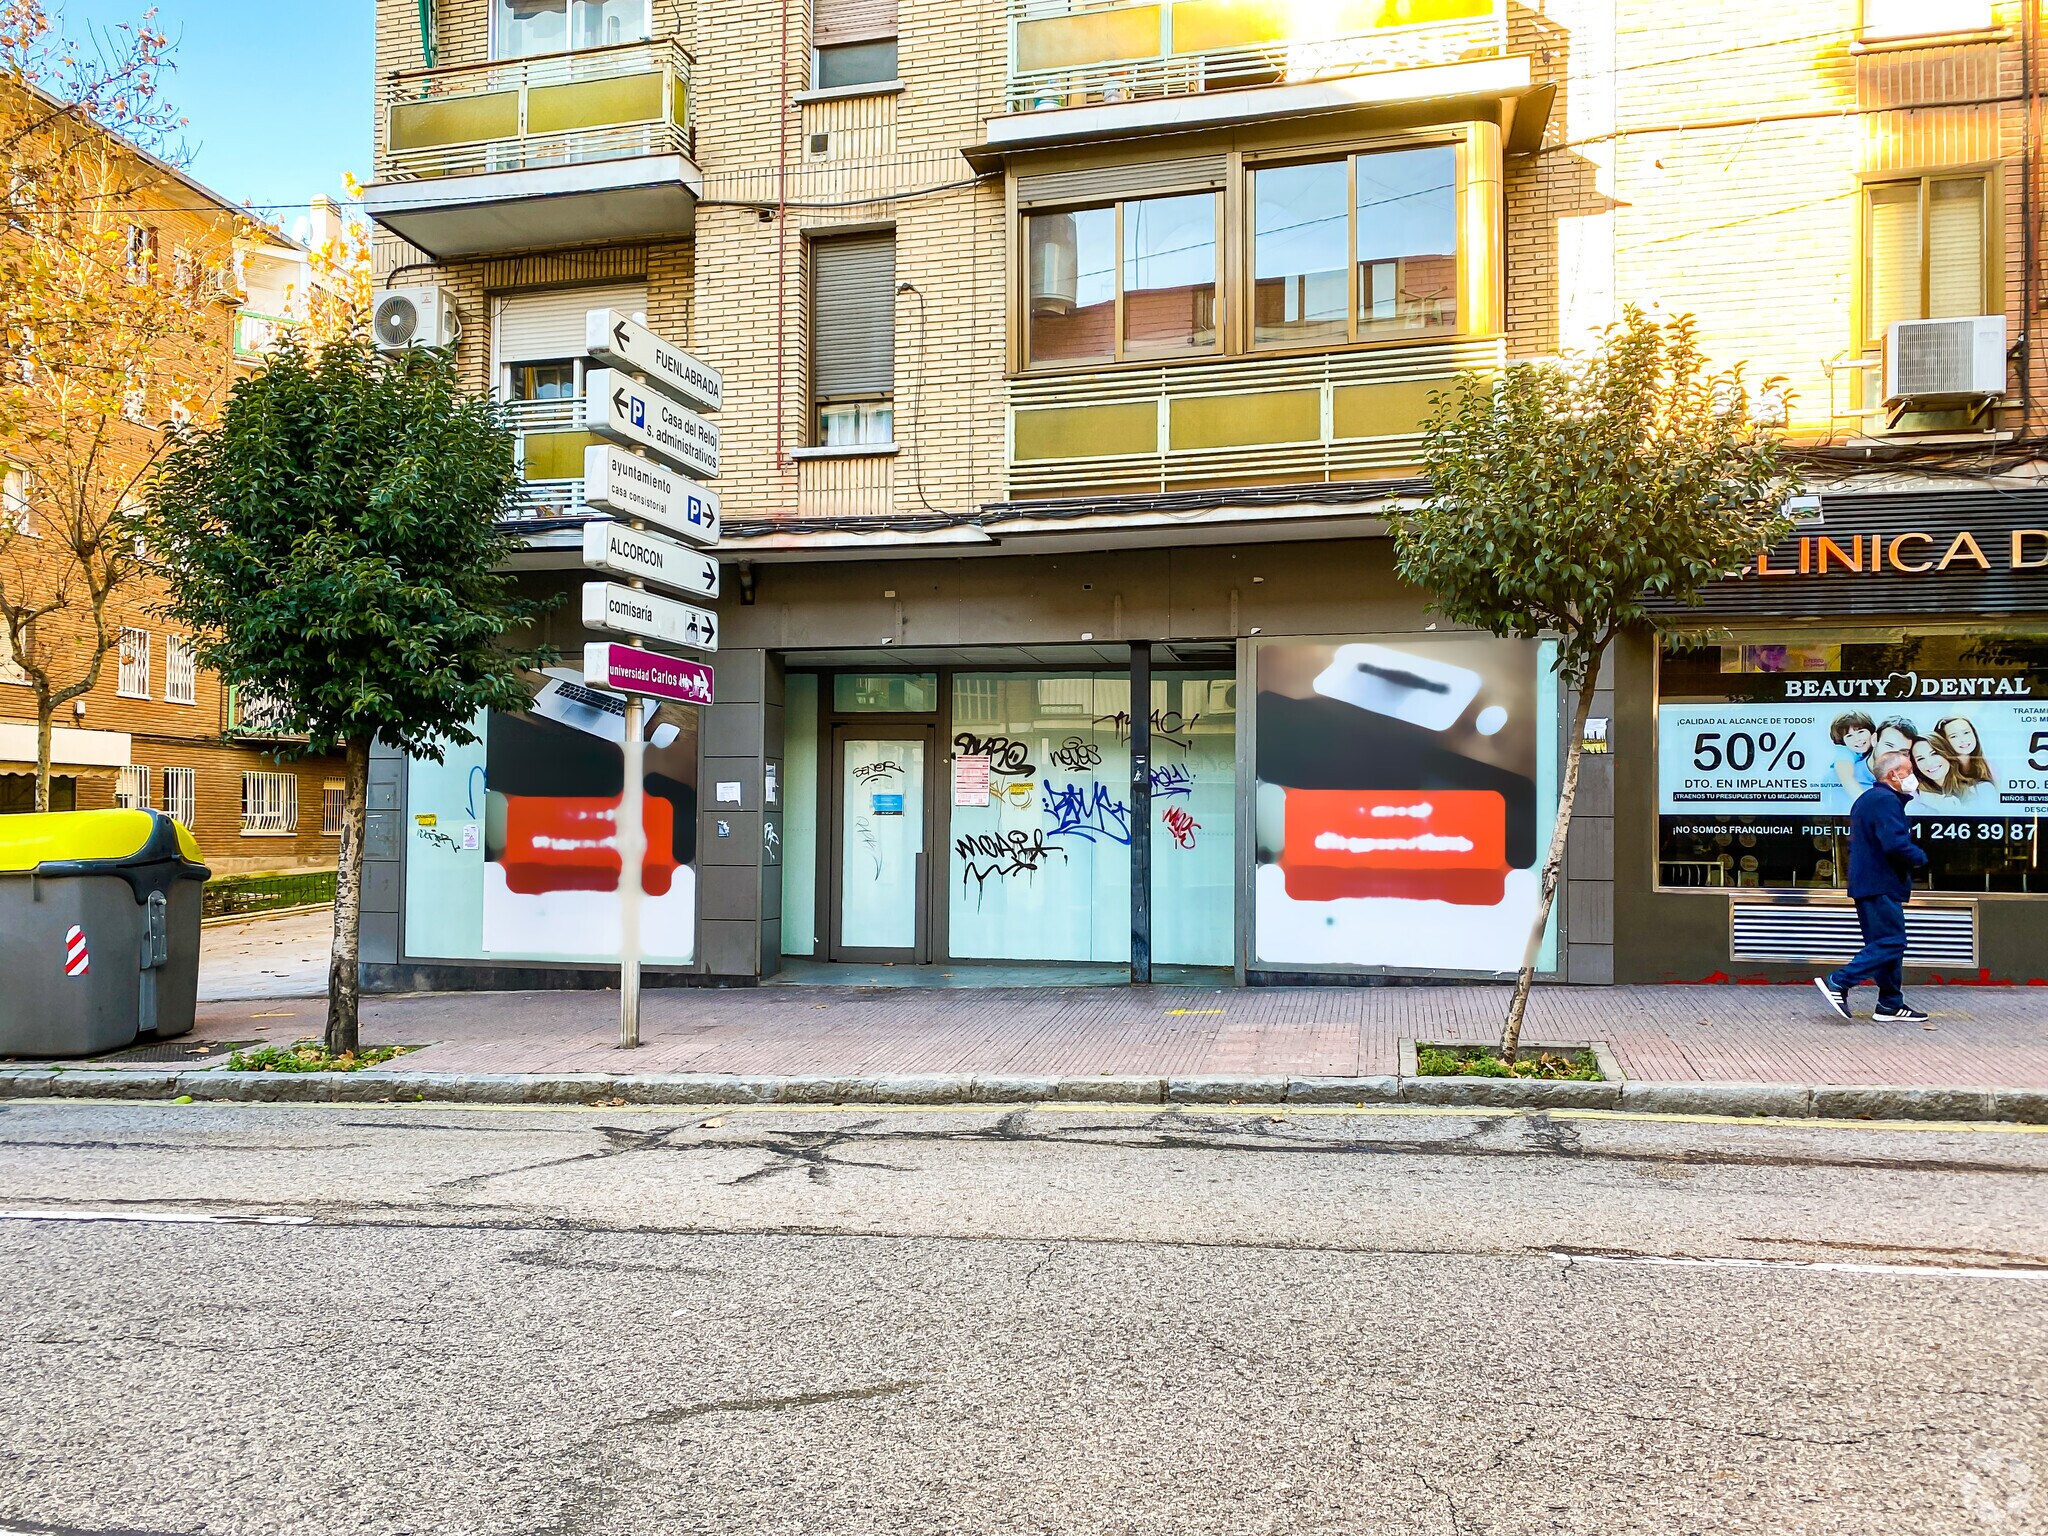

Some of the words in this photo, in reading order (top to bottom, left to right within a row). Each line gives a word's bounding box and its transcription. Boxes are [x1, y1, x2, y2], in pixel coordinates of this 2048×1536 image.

[655, 348, 719, 399] FUENLABRADA
[661, 406, 683, 429] Casa
[684, 419, 697, 437] del
[699, 426, 718, 451] Reloj
[656, 429, 717, 469] administrativos
[611, 459, 671, 495] ayuntamiento
[611, 483, 627, 499] casa
[628, 491, 667, 514] consistorial
[610, 537, 663, 568] ALCORCON
[609, 599, 653, 622] comisaría
[609, 665, 650, 681] universidad
[651, 667, 678, 687] Carlos
[1785, 678, 1890, 698] BEAUTY
[1920, 677, 2031, 696] DENTAL
[1677, 718, 1715, 726] ¡CALIDAD
[1693, 731, 1805, 771] 50%
[1685, 779, 1713, 788] DTO.
[1716, 779, 1733, 788] EN
[1736, 779, 1807, 788] IMPLANTES
[2008, 779, 2040, 789] DTO.
[1692, 826, 1727, 834] SOMOS
[1729, 826, 1793, 834] FRANQUICIA!
[1802, 826, 1832, 836] PIDE
[1930, 823, 1971, 840] 246
[1977, 823, 2004, 840] 39
[2010, 823, 2038, 840] 87
